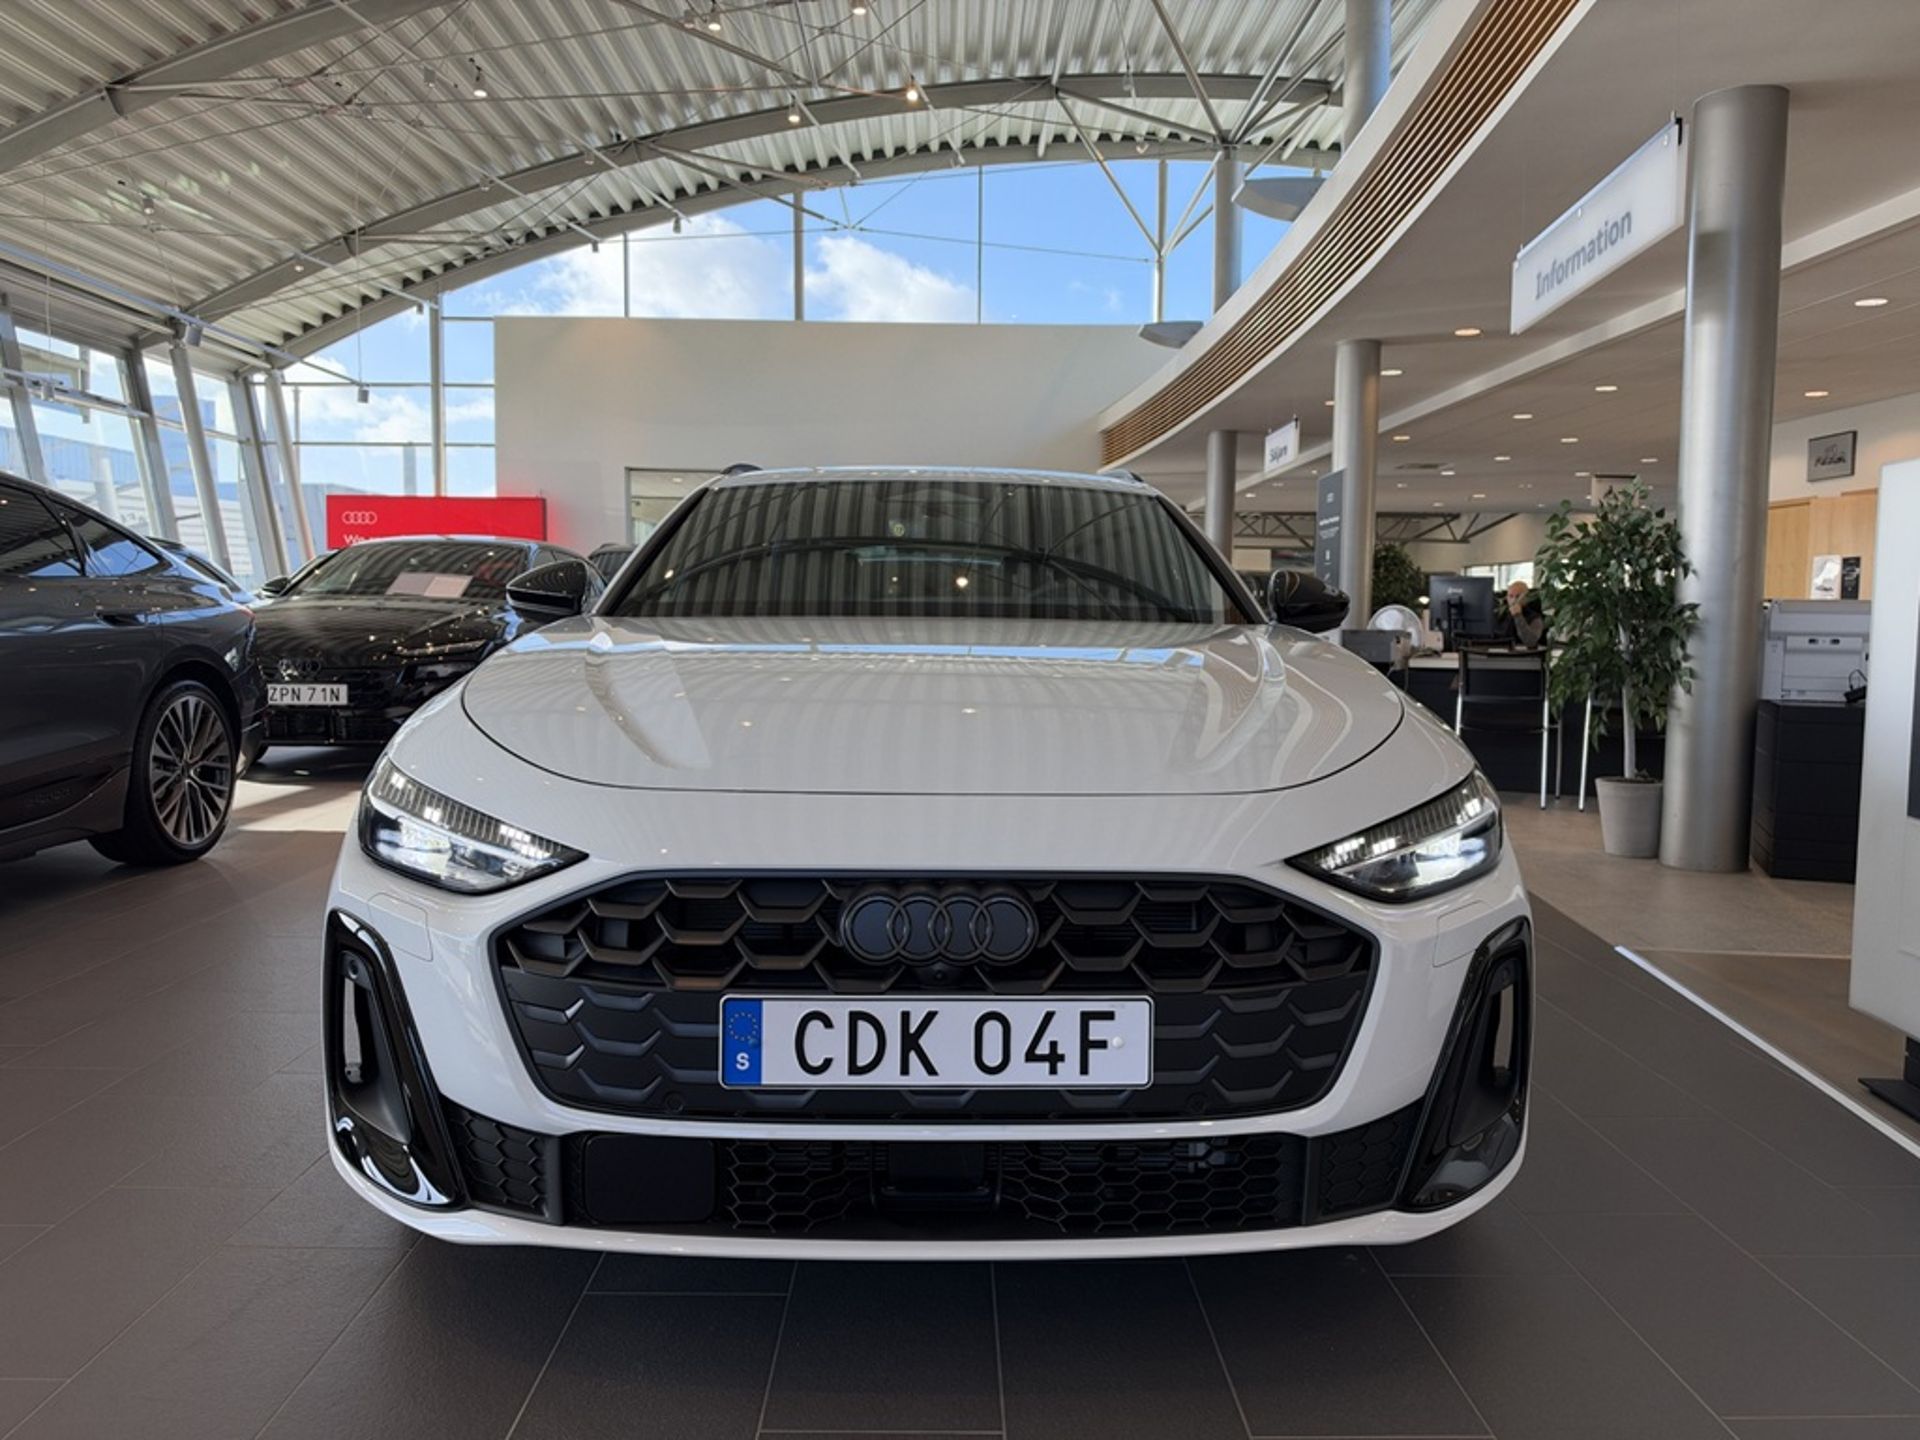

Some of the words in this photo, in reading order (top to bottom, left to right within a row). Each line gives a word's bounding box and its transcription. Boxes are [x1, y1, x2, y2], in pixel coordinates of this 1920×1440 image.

[1535, 210, 1632, 301] Information
[269, 687, 300, 702] ZPN
[307, 687, 340, 702] 71N
[736, 1052, 750, 1070] S
[794, 1010, 939, 1076] CDK
[973, 1010, 1116, 1076] 04F
